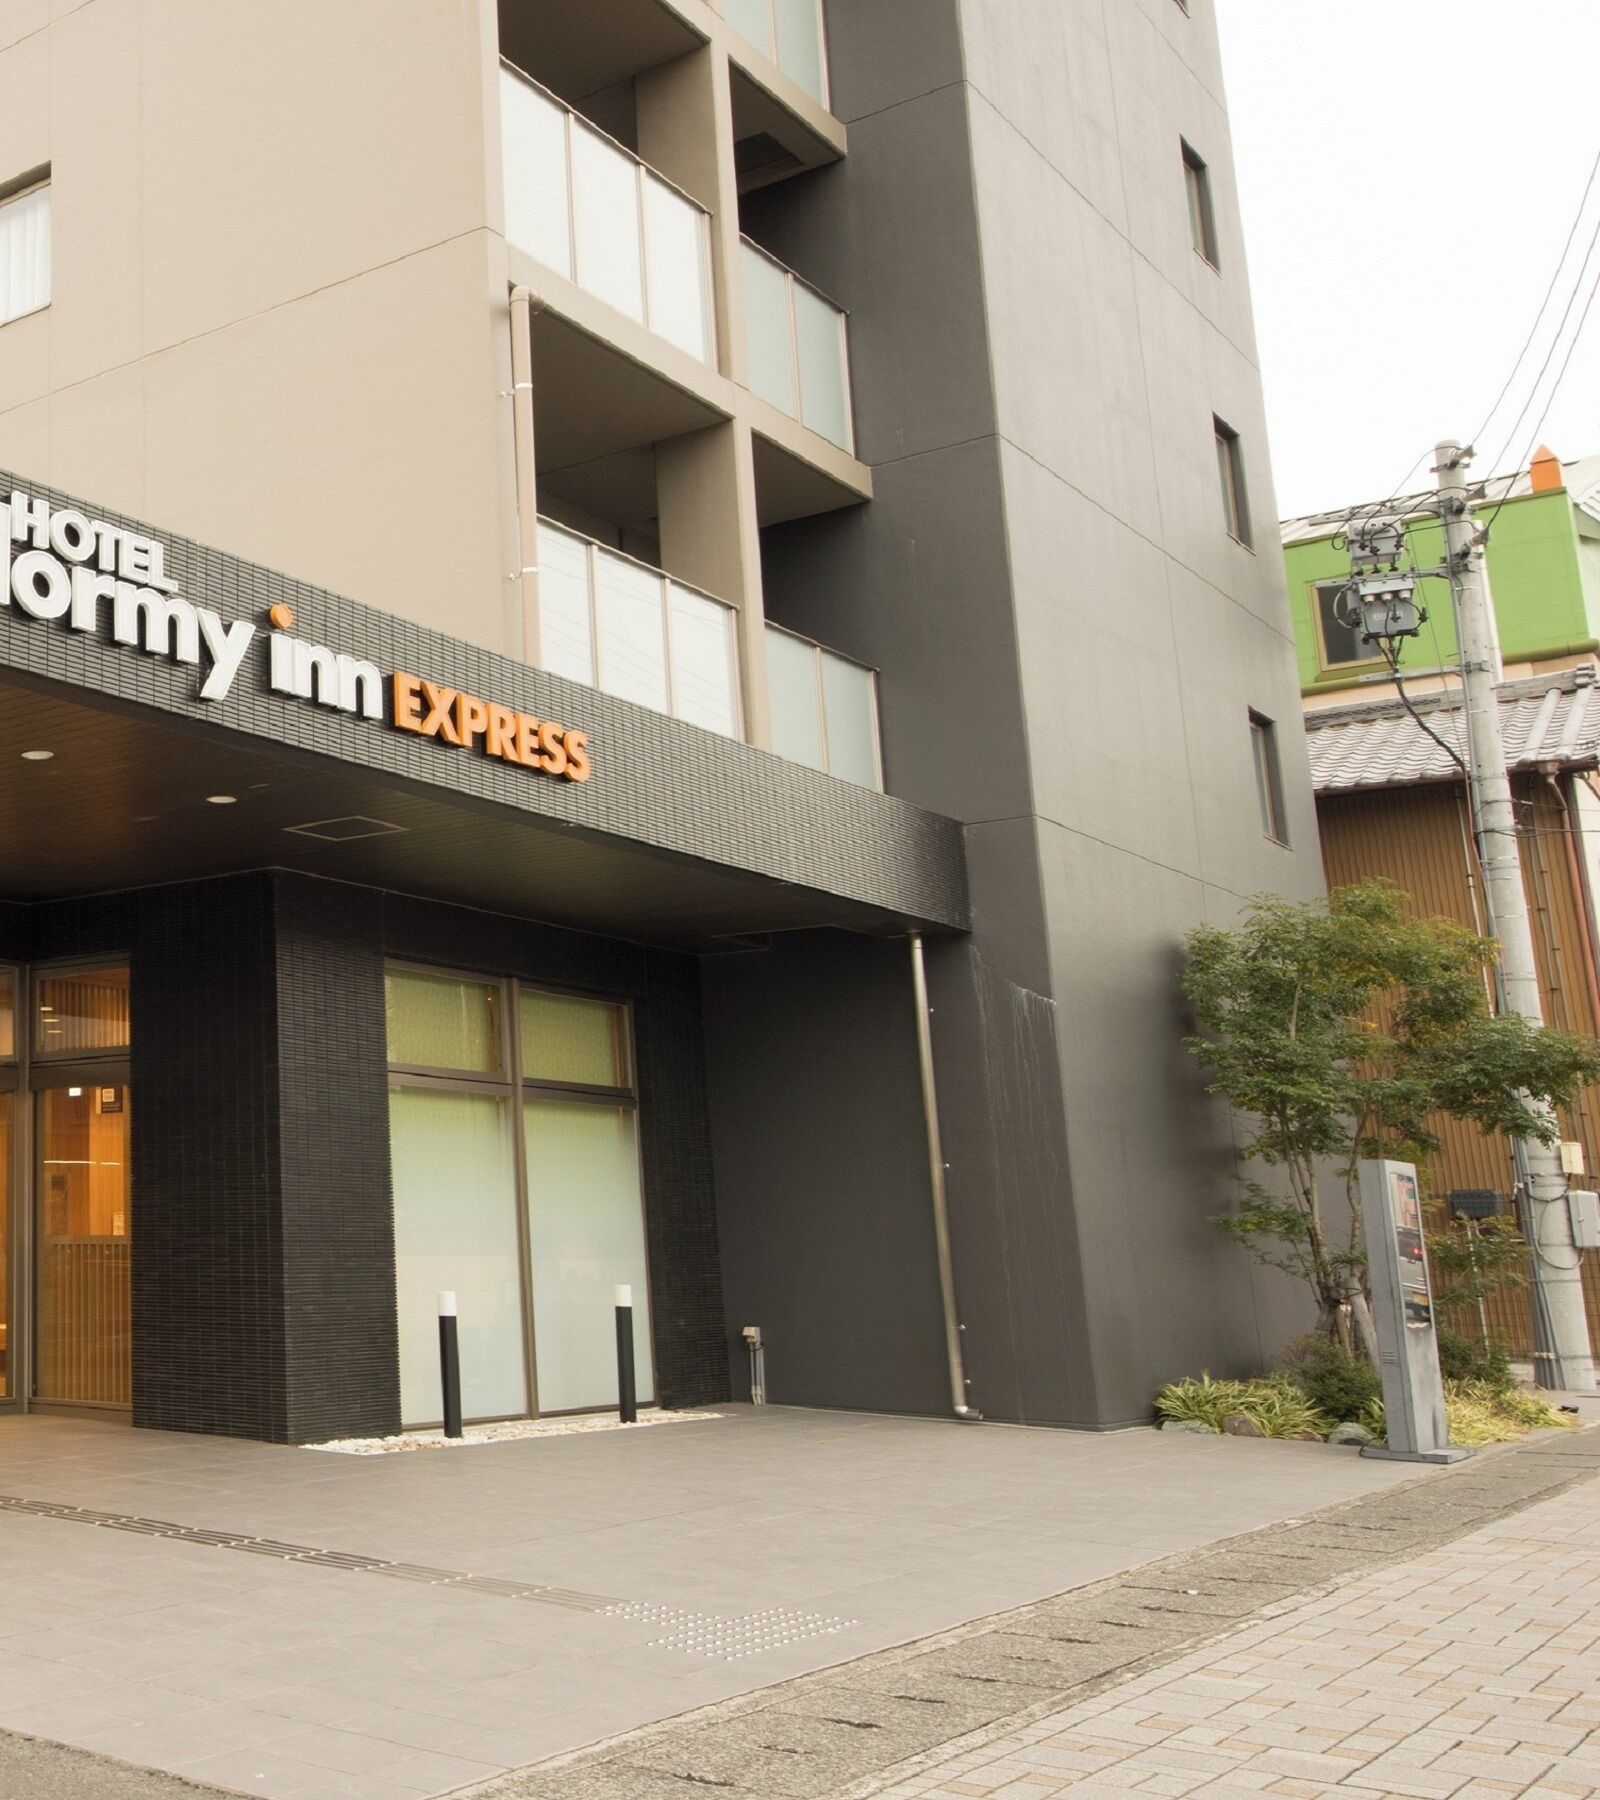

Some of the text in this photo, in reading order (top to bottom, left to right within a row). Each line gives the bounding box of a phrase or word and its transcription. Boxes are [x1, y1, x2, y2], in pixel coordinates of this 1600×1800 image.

[11, 490, 178, 593] HOTEL
[270, 604, 383, 719] inn
[394, 672, 591, 782] EXPRESS
